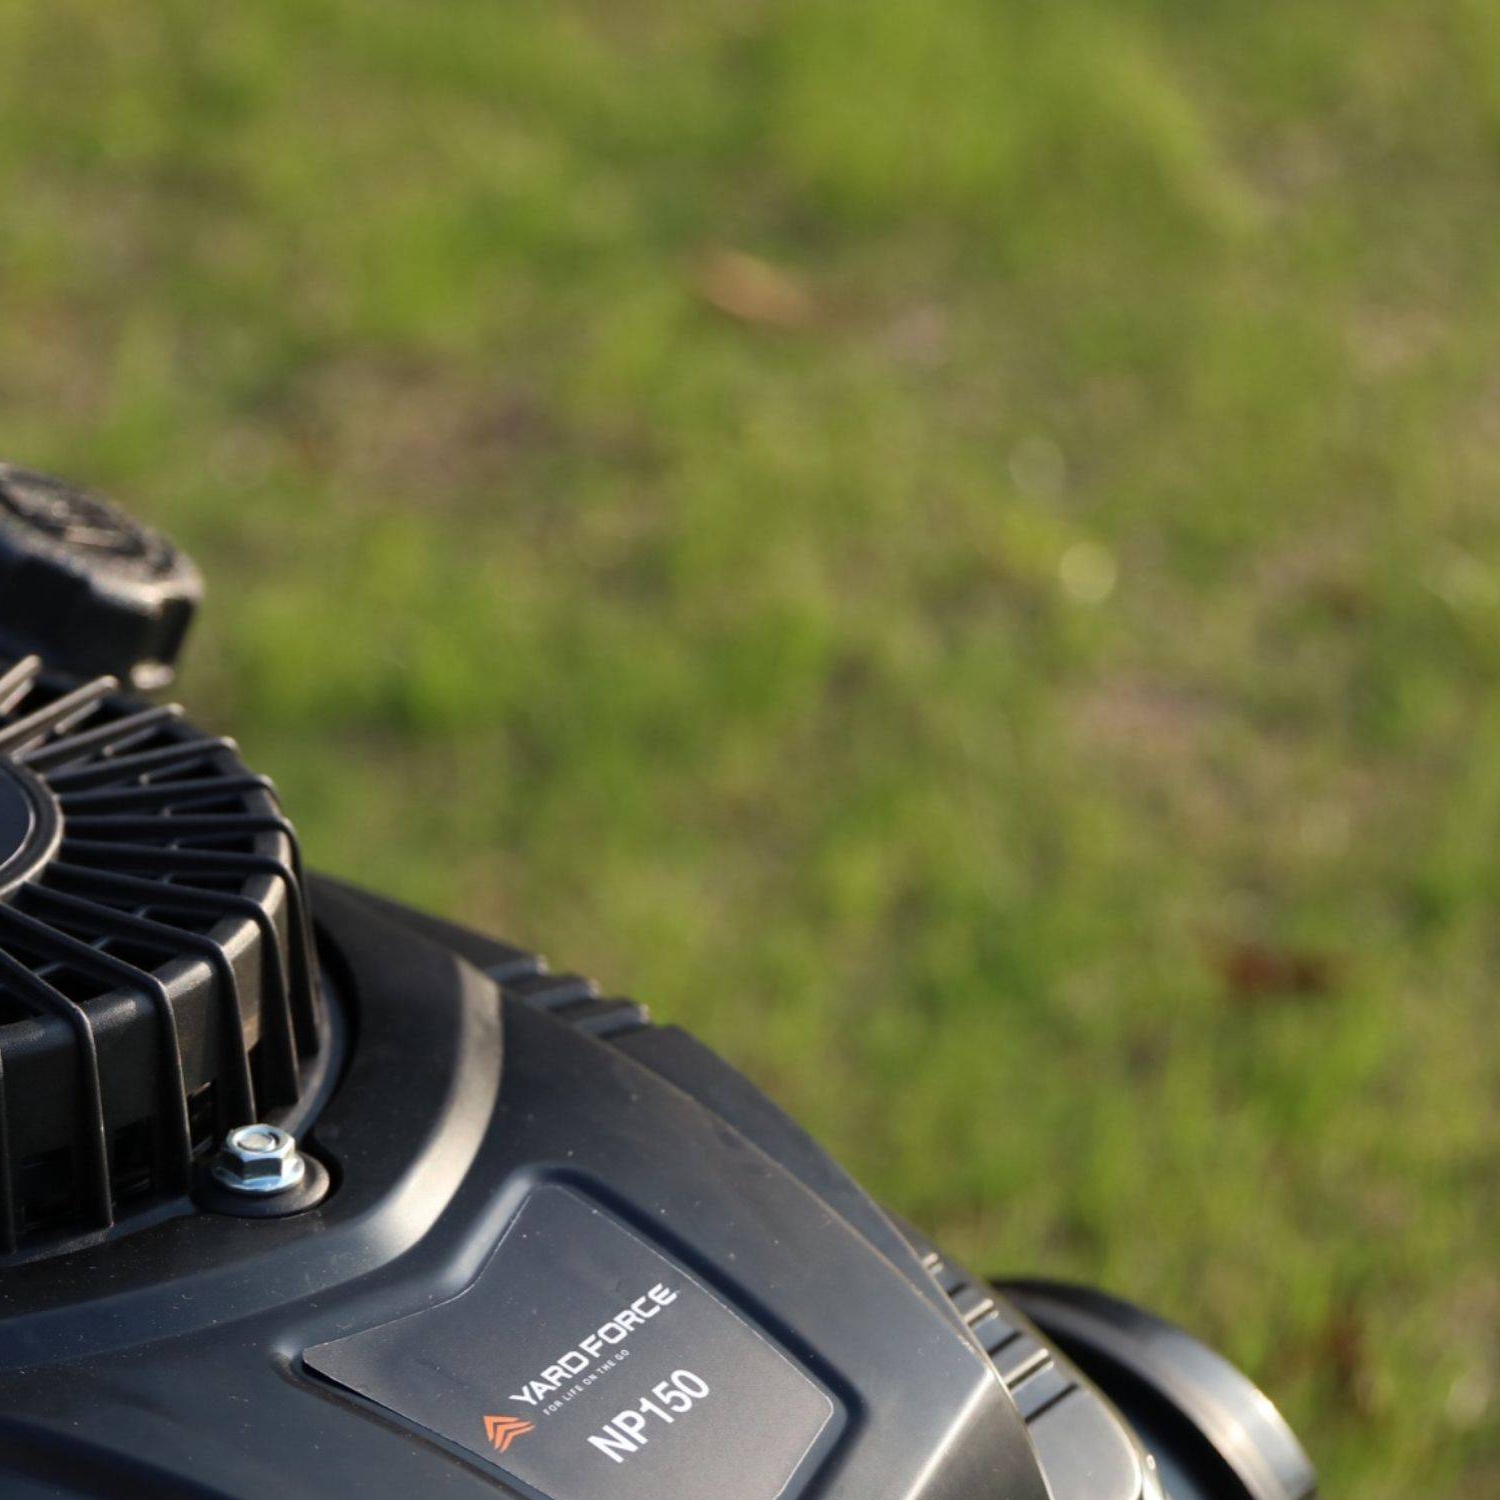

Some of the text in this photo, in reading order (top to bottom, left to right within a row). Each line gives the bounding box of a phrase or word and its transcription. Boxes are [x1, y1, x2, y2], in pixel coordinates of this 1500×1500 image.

[542, 1348, 630, 1416] FOR LIFE ON THE GO
[587, 1369, 710, 1464] NP150
